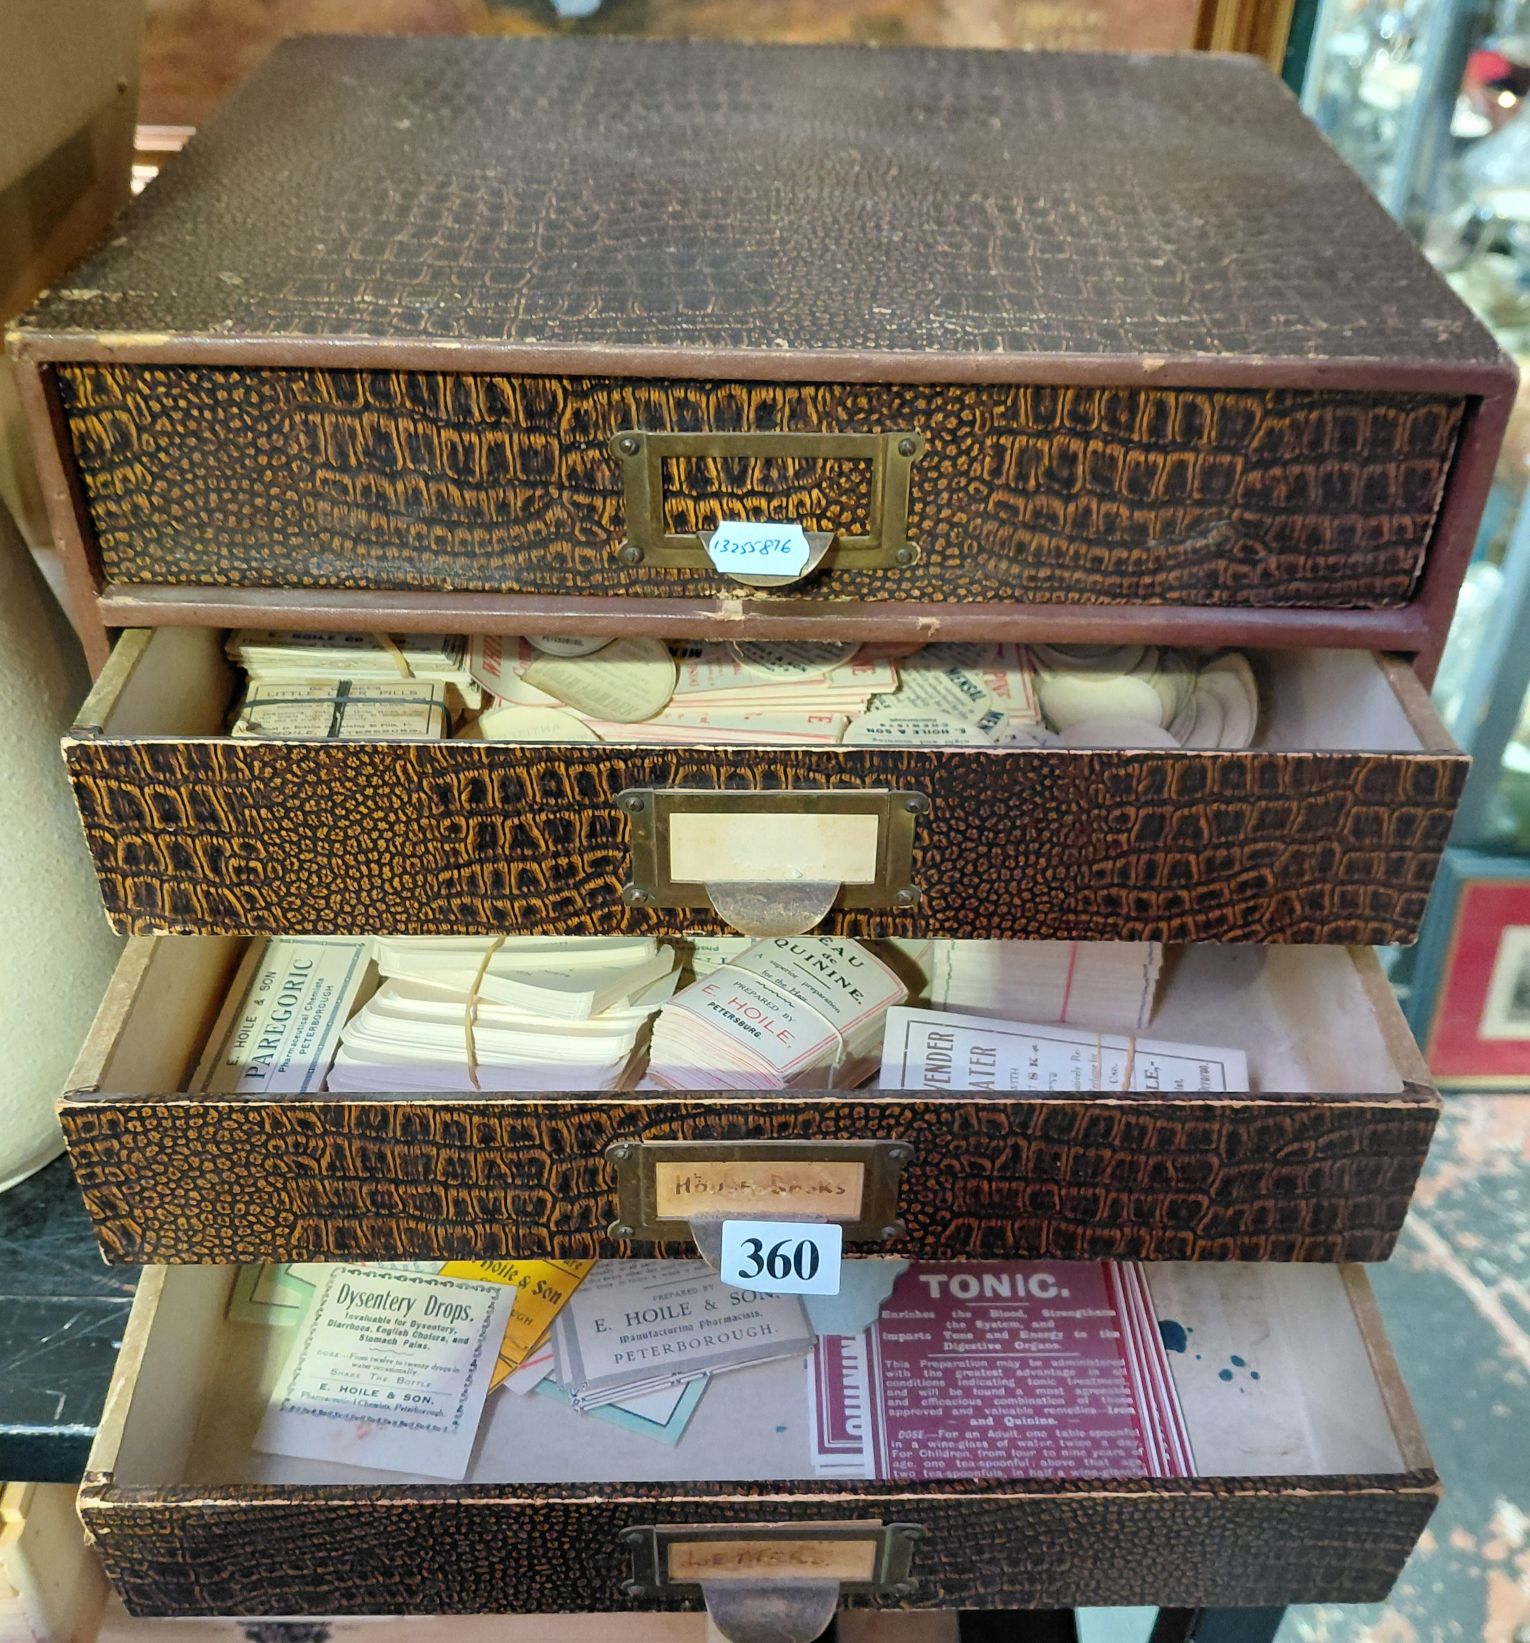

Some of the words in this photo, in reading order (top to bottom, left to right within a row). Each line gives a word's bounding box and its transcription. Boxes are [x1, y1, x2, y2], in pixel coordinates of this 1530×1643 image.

[714, 539, 792, 555] 13255876
[818, 936, 864, 968] EAU
[822, 952, 838, 964] de
[774, 938, 864, 1005] QUININE.
[762, 970, 773, 978] for
[774, 978, 788, 989] the
[770, 960, 799, 979] superior
[801, 981, 841, 1014] preparation
[732, 981, 779, 1012] PREPARED
[782, 1013, 795, 1022] BY
[234, 1016, 257, 1048] HOILE
[254, 999, 265, 1007] &
[260, 971, 277, 991] SON
[244, 959, 314, 1079] PAREGORIC
[299, 985, 334, 1055] PETERBOROUGH
[707, 1001, 762, 1040] PETERSBURG.
[738, 1237, 820, 1281] 360
[518, 1275, 531, 1290] &
[532, 1280, 563, 1305] Son
[919, 1273, 1070, 1299] TONIC.
[336, 1283, 415, 1318] Dysentery
[424, 1294, 475, 1324] Drops.
[344, 1312, 392, 1326] Invaluable
[394, 1318, 408, 1327] for
[594, 1318, 612, 1333] E.
[625, 1302, 693, 1327] HOILE
[704, 1298, 718, 1311] &
[881, 1310, 936, 1319] Enriches
[951, 1309, 972, 1318] the
[946, 1320, 967, 1329] the
[1031, 1320, 1055, 1328] and
[358, 1333, 398, 1346] Stomach
[375, 1325, 409, 1338] English
[452, 1335, 469, 1345] and
[882, 1331, 932, 1342] Imparts
[943, 1331, 974, 1339] Tone
[985, 1330, 1009, 1339] and
[1074, 1330, 1087, 1338] to
[1100, 1329, 1120, 1338] the
[614, 1322, 779, 1365] PETERBOROUGH.
[943, 1342, 1002, 1352] Digestive
[885, 1360, 910, 1368] This
[920, 1360, 988, 1369] Preparation
[996, 1360, 1020, 1369] may
[1029, 1359, 1042, 1367] be
[886, 1369, 911, 1377] with
[923, 1369, 943, 1377] the
[955, 1369, 1003, 1378] greatest
[1015, 1368, 1076, 1377] advantage
[886, 1378, 946, 1387] conditions
[957, 1378, 1016, 1388] indicating
[319, 1383, 331, 1391] E.
[339, 1385, 380, 1398] HOILE
[386, 1391, 396, 1400] &
[887, 1389, 908, 1397] and
[918, 1388, 939, 1396] will
[949, 1388, 963, 1396] be
[972, 1388, 1005, 1396] found
[887, 1398, 909, 1406] and
[921, 1398, 982, 1406] efficacious
[993, 1397, 1065, 1406] combination
[889, 1407, 943, 1416] approved
[952, 1407, 973, 1415] and
[984, 1407, 1034, 1415] valuable
[970, 1416, 994, 1425] and
[965, 1430, 980, 1438] an
[1026, 1430, 1047, 1438] one
[911, 1440, 919, 1448] a
[996, 1439, 1008, 1447] of
[892, 1450, 913, 1458] For
[978, 1449, 1006, 1457] from
[1011, 1448, 1036, 1457] four
[1043, 1448, 1056, 1457] to
[1061, 1448, 1087, 1457] nine
[923, 1460, 946, 1468] one
[1040, 1459, 1075, 1467] above
[1083, 1458, 1110, 1467] that
[893, 1470, 916, 1478] two
[1012, 1469, 1024, 1478] in
[1028, 1469, 1053, 1478] half
[1057, 1470, 1066, 1478] a
